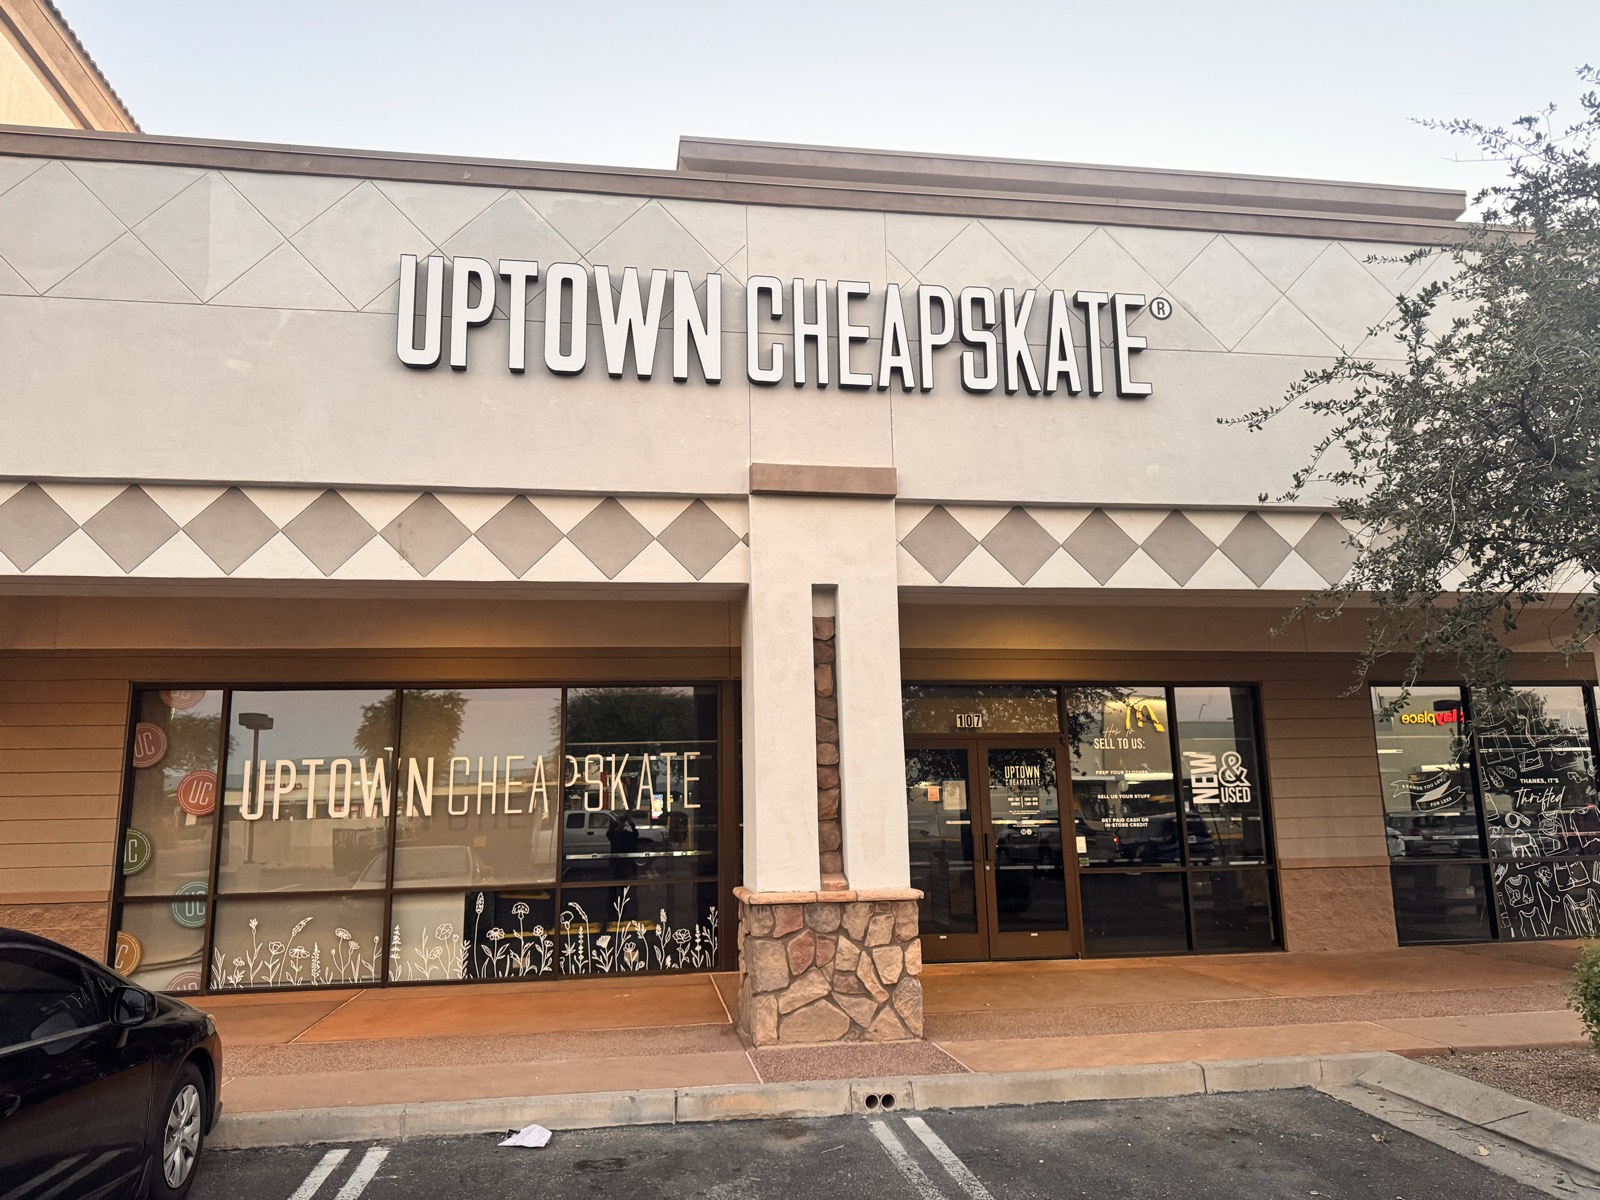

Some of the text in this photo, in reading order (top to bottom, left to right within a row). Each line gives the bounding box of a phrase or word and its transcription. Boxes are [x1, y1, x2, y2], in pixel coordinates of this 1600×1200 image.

[397, 253, 722, 384] UPTOWN
[958, 714, 981, 727] 107
[1094, 737, 1146, 750] SELL TO US:
[1004, 765, 1040, 779] UPTOWN
[1183, 751, 1220, 804] NEW
[189, 780, 213, 805] UC
[241, 751, 701, 821] UPTOWN CHEAPSKATE
[1220, 787, 1251, 803] USED
[1514, 785, 1566, 811] Thrifted
